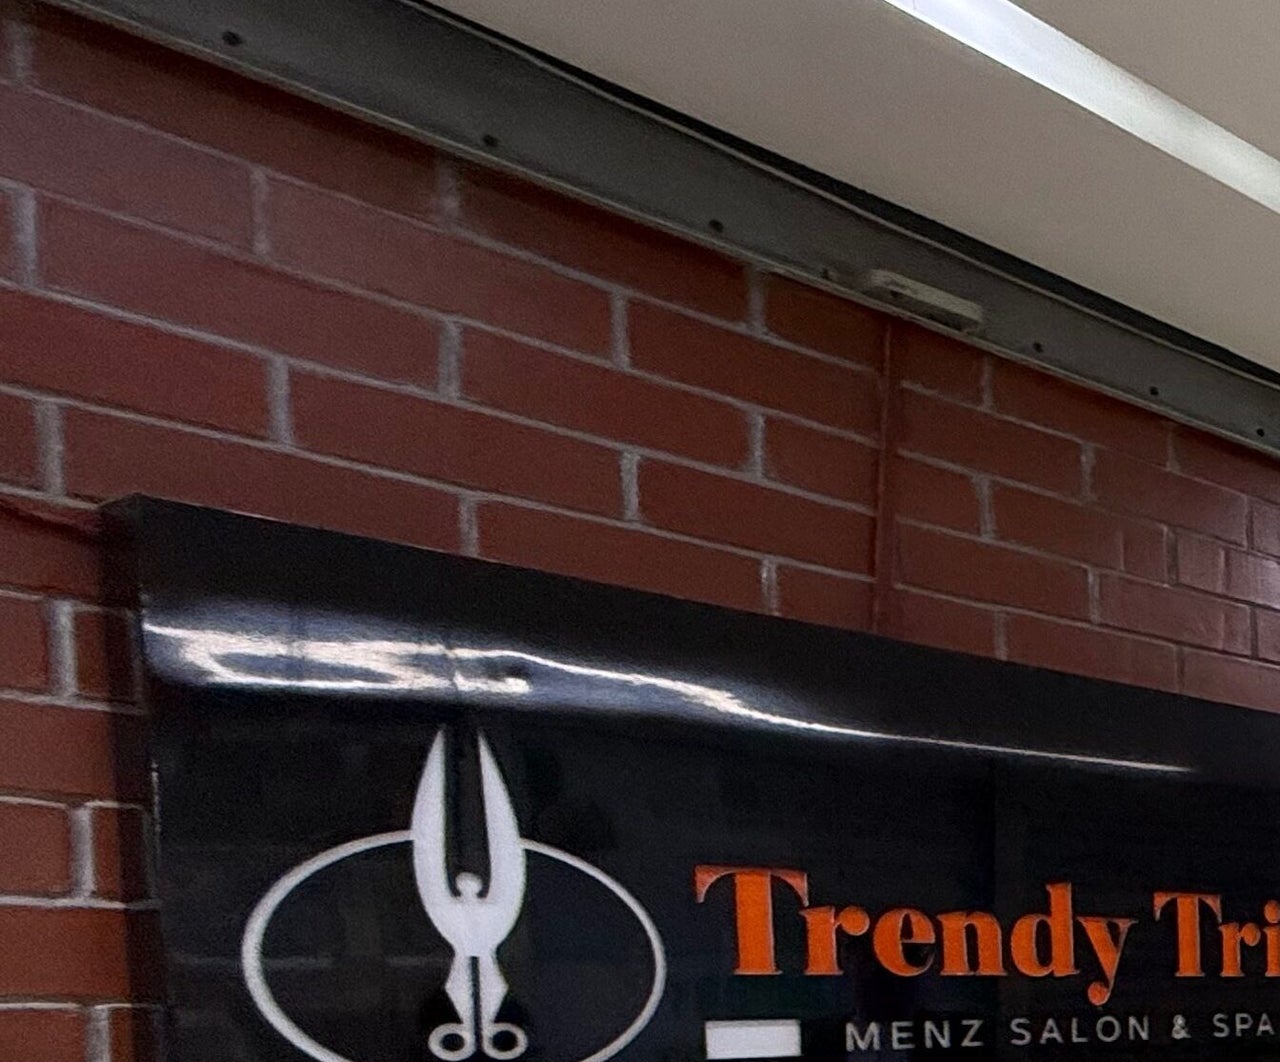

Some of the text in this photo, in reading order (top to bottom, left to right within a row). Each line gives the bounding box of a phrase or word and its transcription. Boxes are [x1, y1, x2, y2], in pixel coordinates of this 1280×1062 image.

[694, 863, 1137, 1005] Trendy
[845, 1012, 1276, 1052] MENZ SALON & SPA
